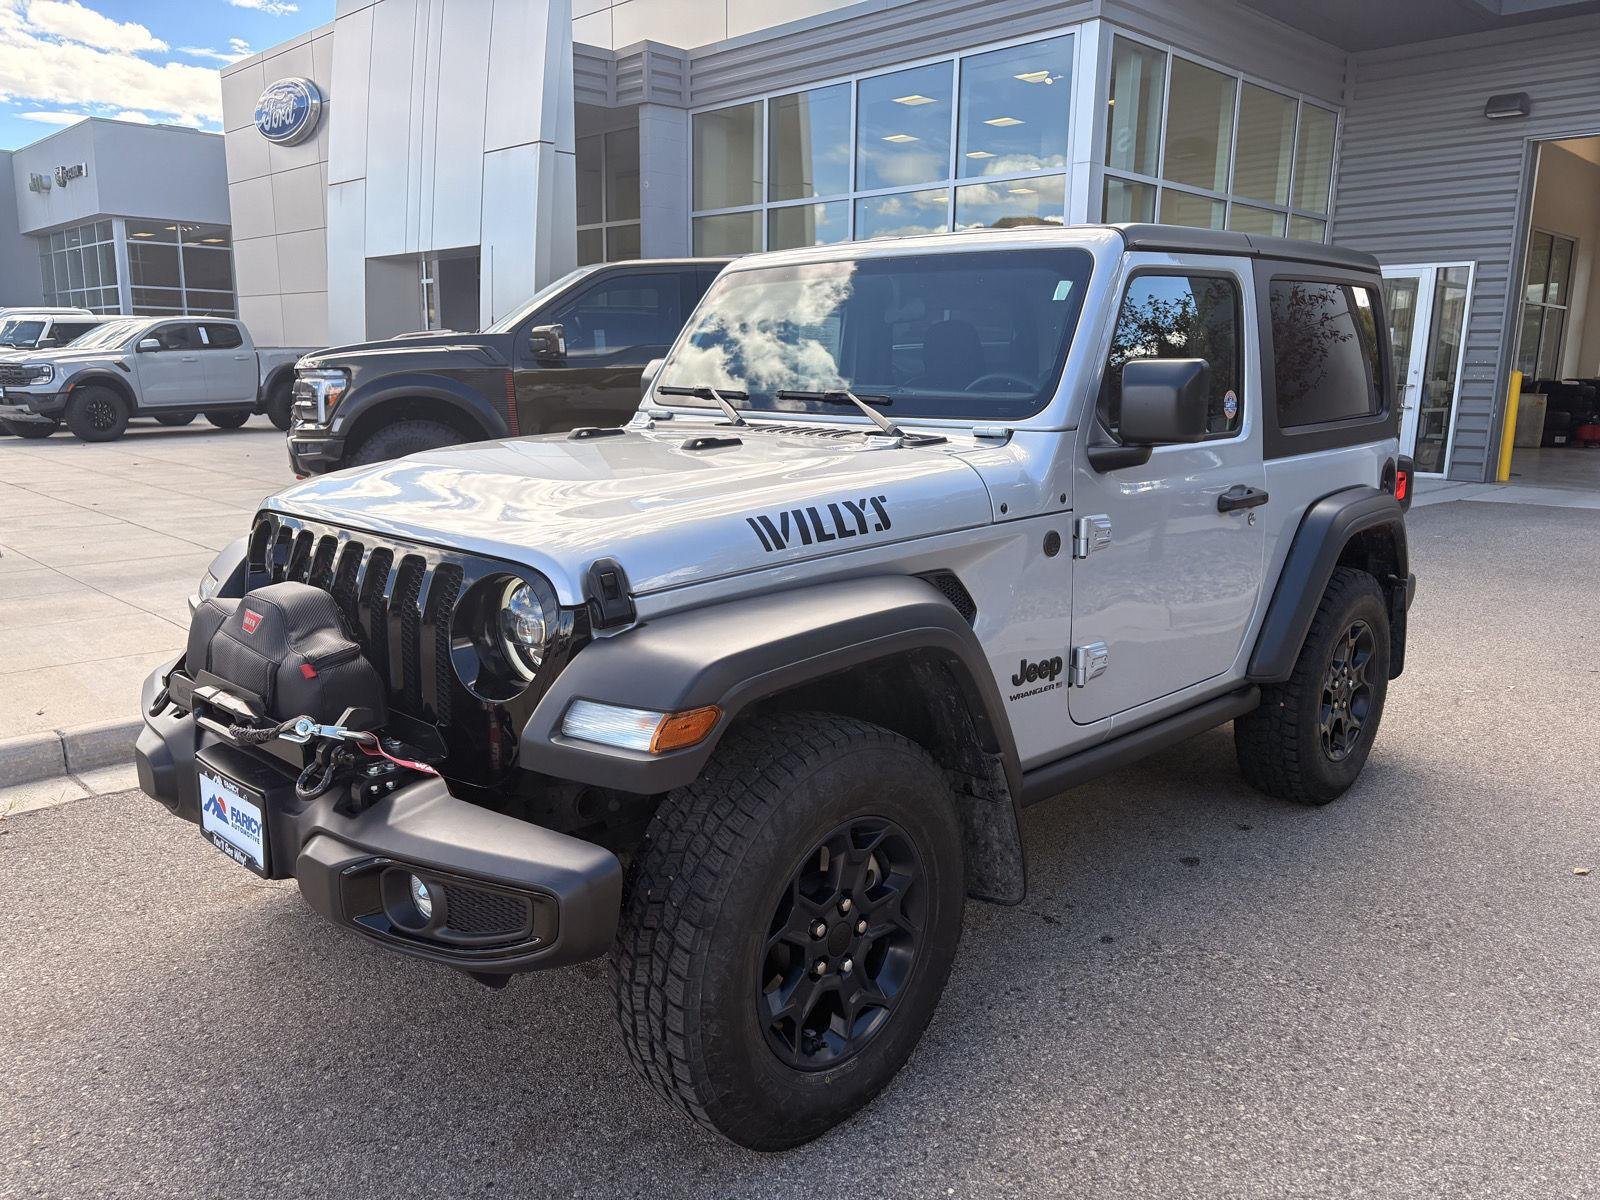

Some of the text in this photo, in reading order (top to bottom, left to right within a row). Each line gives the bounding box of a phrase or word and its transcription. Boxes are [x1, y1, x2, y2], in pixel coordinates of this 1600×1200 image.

[260, 91, 298, 131] Ford
[746, 495, 891, 552] WILLYS
[1011, 656, 1062, 687] Jeep
[1009, 683, 1055, 702] WRANGLER
[230, 806, 262, 837] FARICY
[231, 821, 260, 845] AUTOMOTIVE
